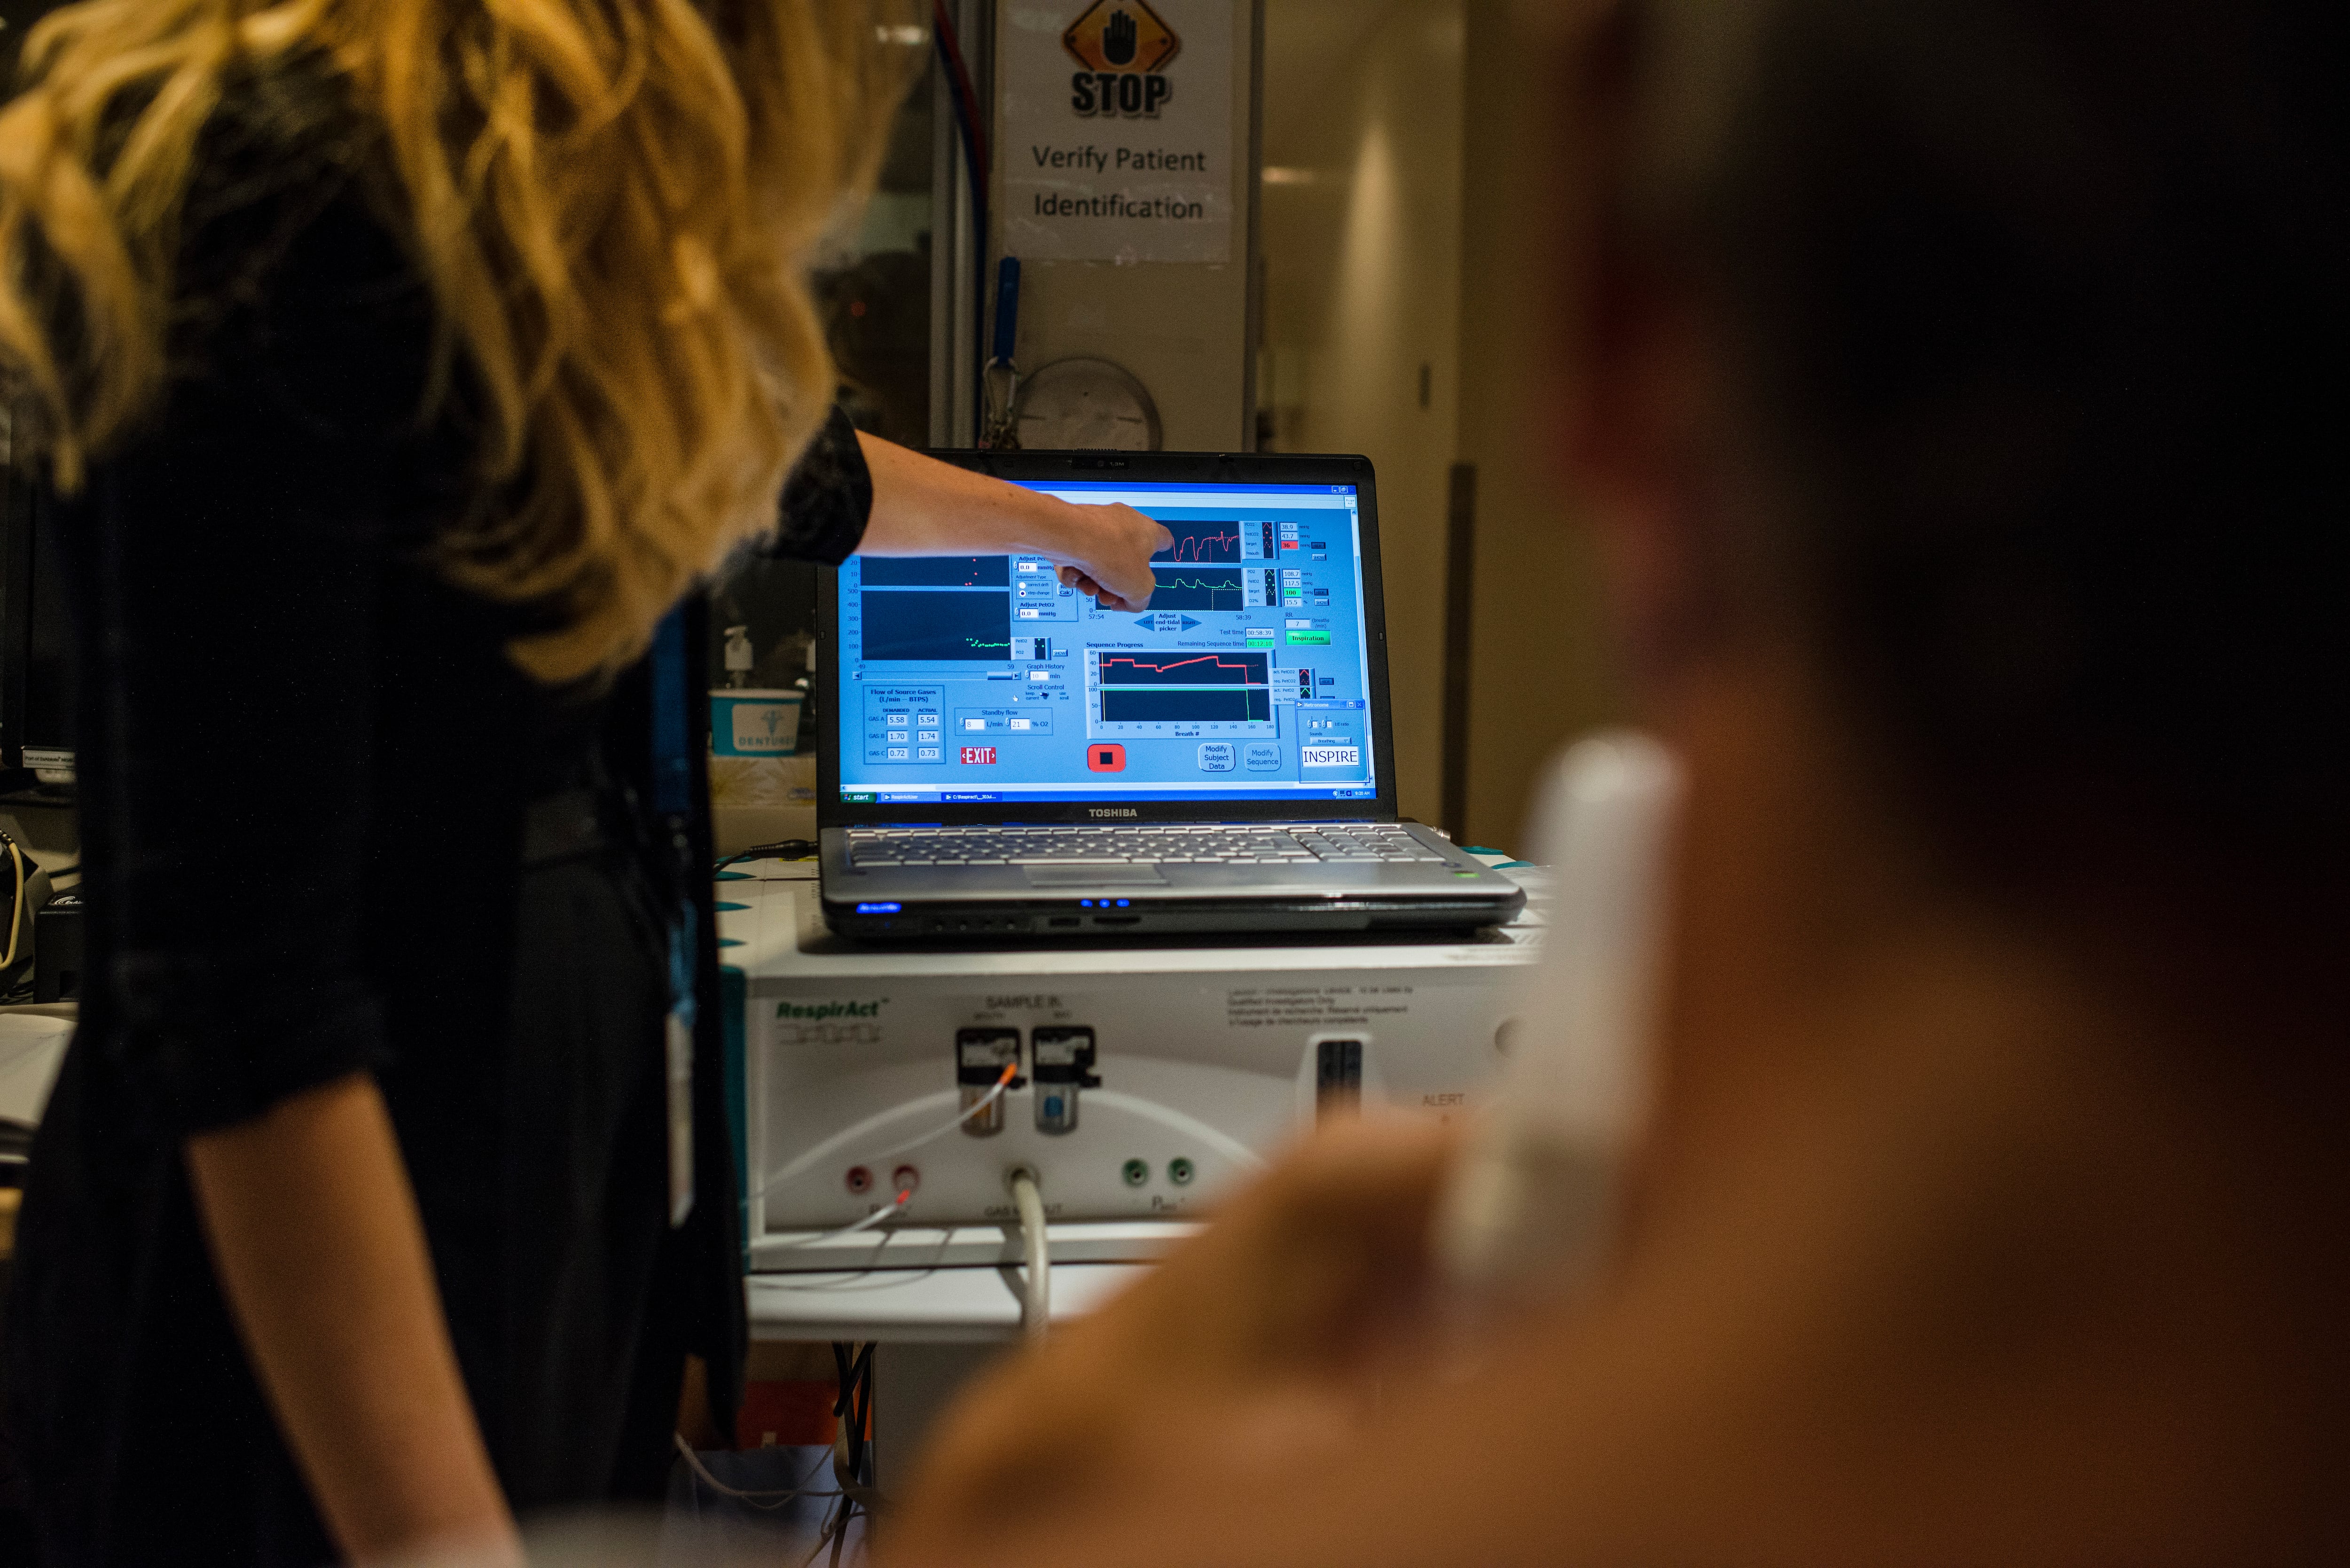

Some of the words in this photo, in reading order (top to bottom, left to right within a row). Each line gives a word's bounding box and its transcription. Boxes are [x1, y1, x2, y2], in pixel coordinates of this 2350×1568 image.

[1071, 71, 1171, 119] STOP
[1032, 146, 1108, 173] Verify
[1116, 147, 1206, 172] Patient
[1034, 194, 1203, 219] Identification
[965, 748, 992, 764] EXIT
[1303, 750, 1358, 763] INSPIRE
[1089, 809, 1138, 818] TOSHIBA
[986, 994, 1044, 1010] SAMPLE
[1422, 1093, 1465, 1107] ALERT
